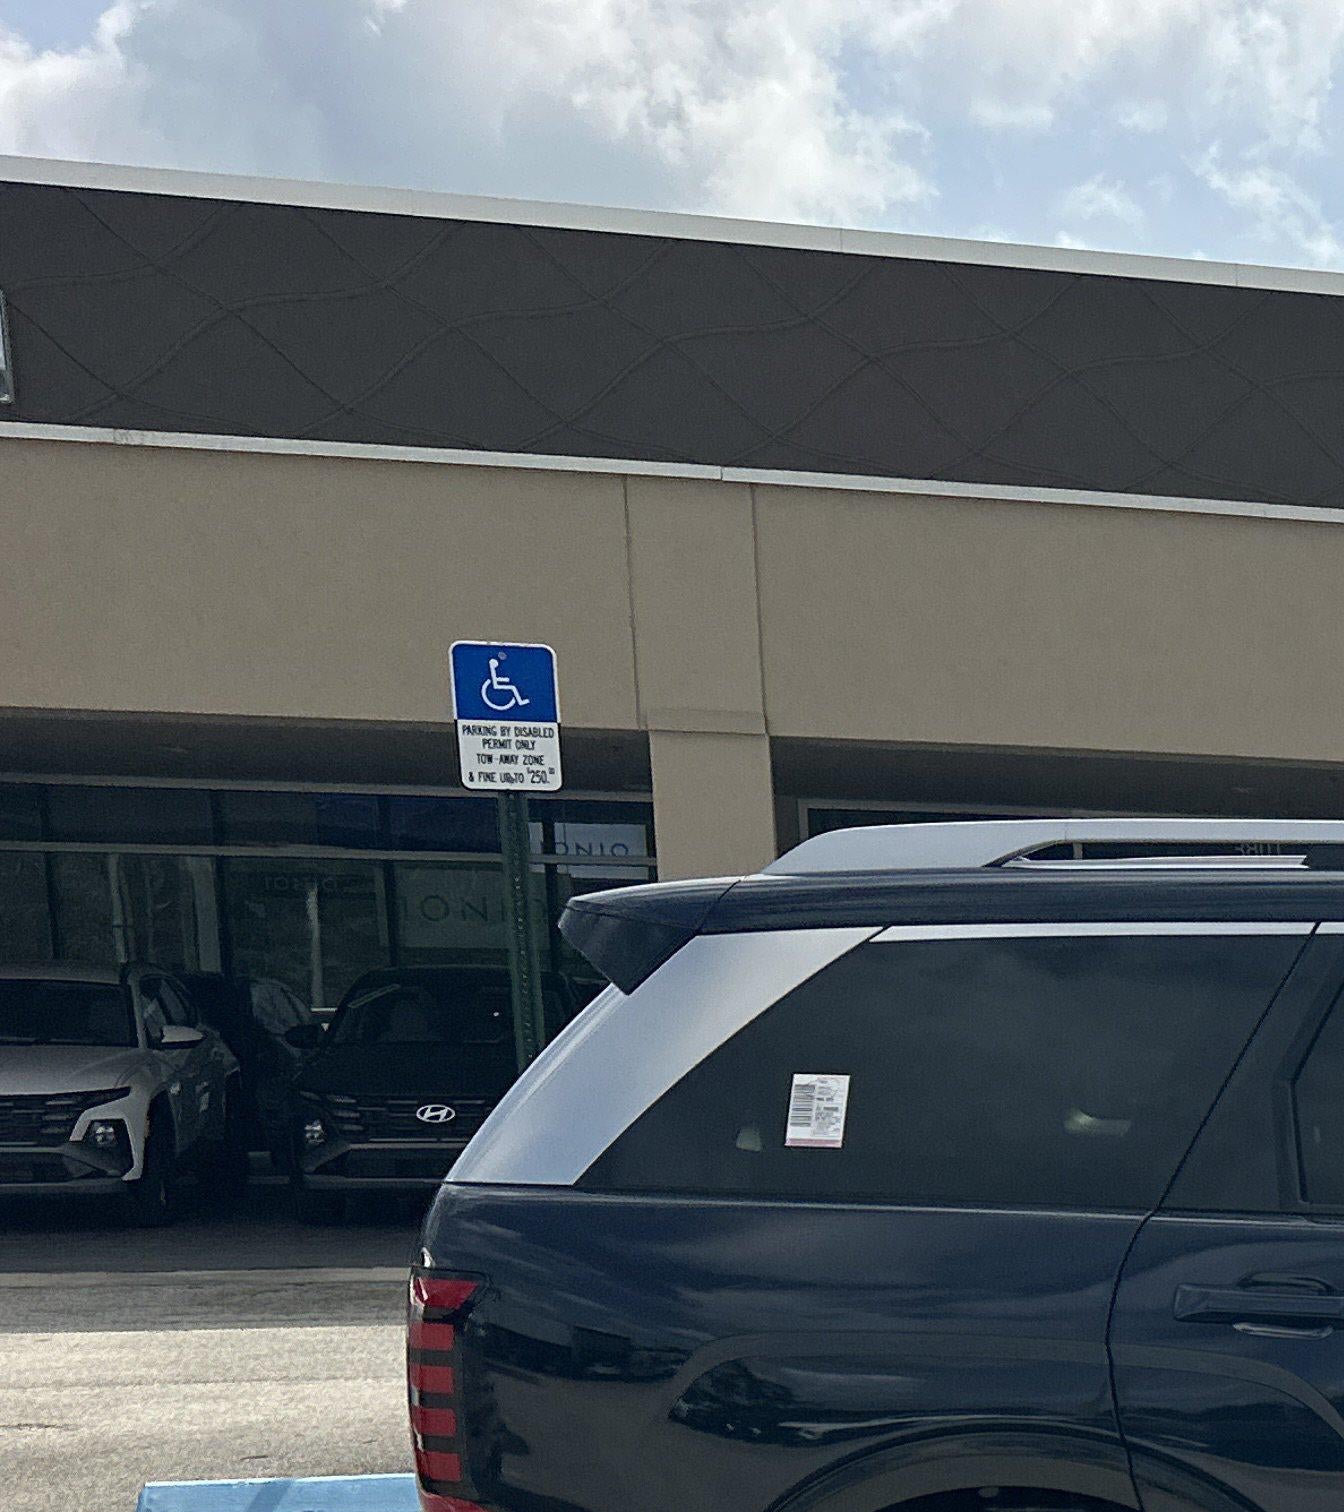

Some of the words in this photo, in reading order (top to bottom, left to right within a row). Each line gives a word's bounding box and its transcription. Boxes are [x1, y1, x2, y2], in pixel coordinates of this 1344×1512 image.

[462, 724, 497, 736] PARKING
[500, 726, 511, 737] BY
[514, 726, 554, 738] DISABLED
[482, 738, 512, 750] PERMIT
[515, 740, 536, 750] ONLY
[523, 755, 544, 766] ZONE
[478, 772, 496, 783] FINE
